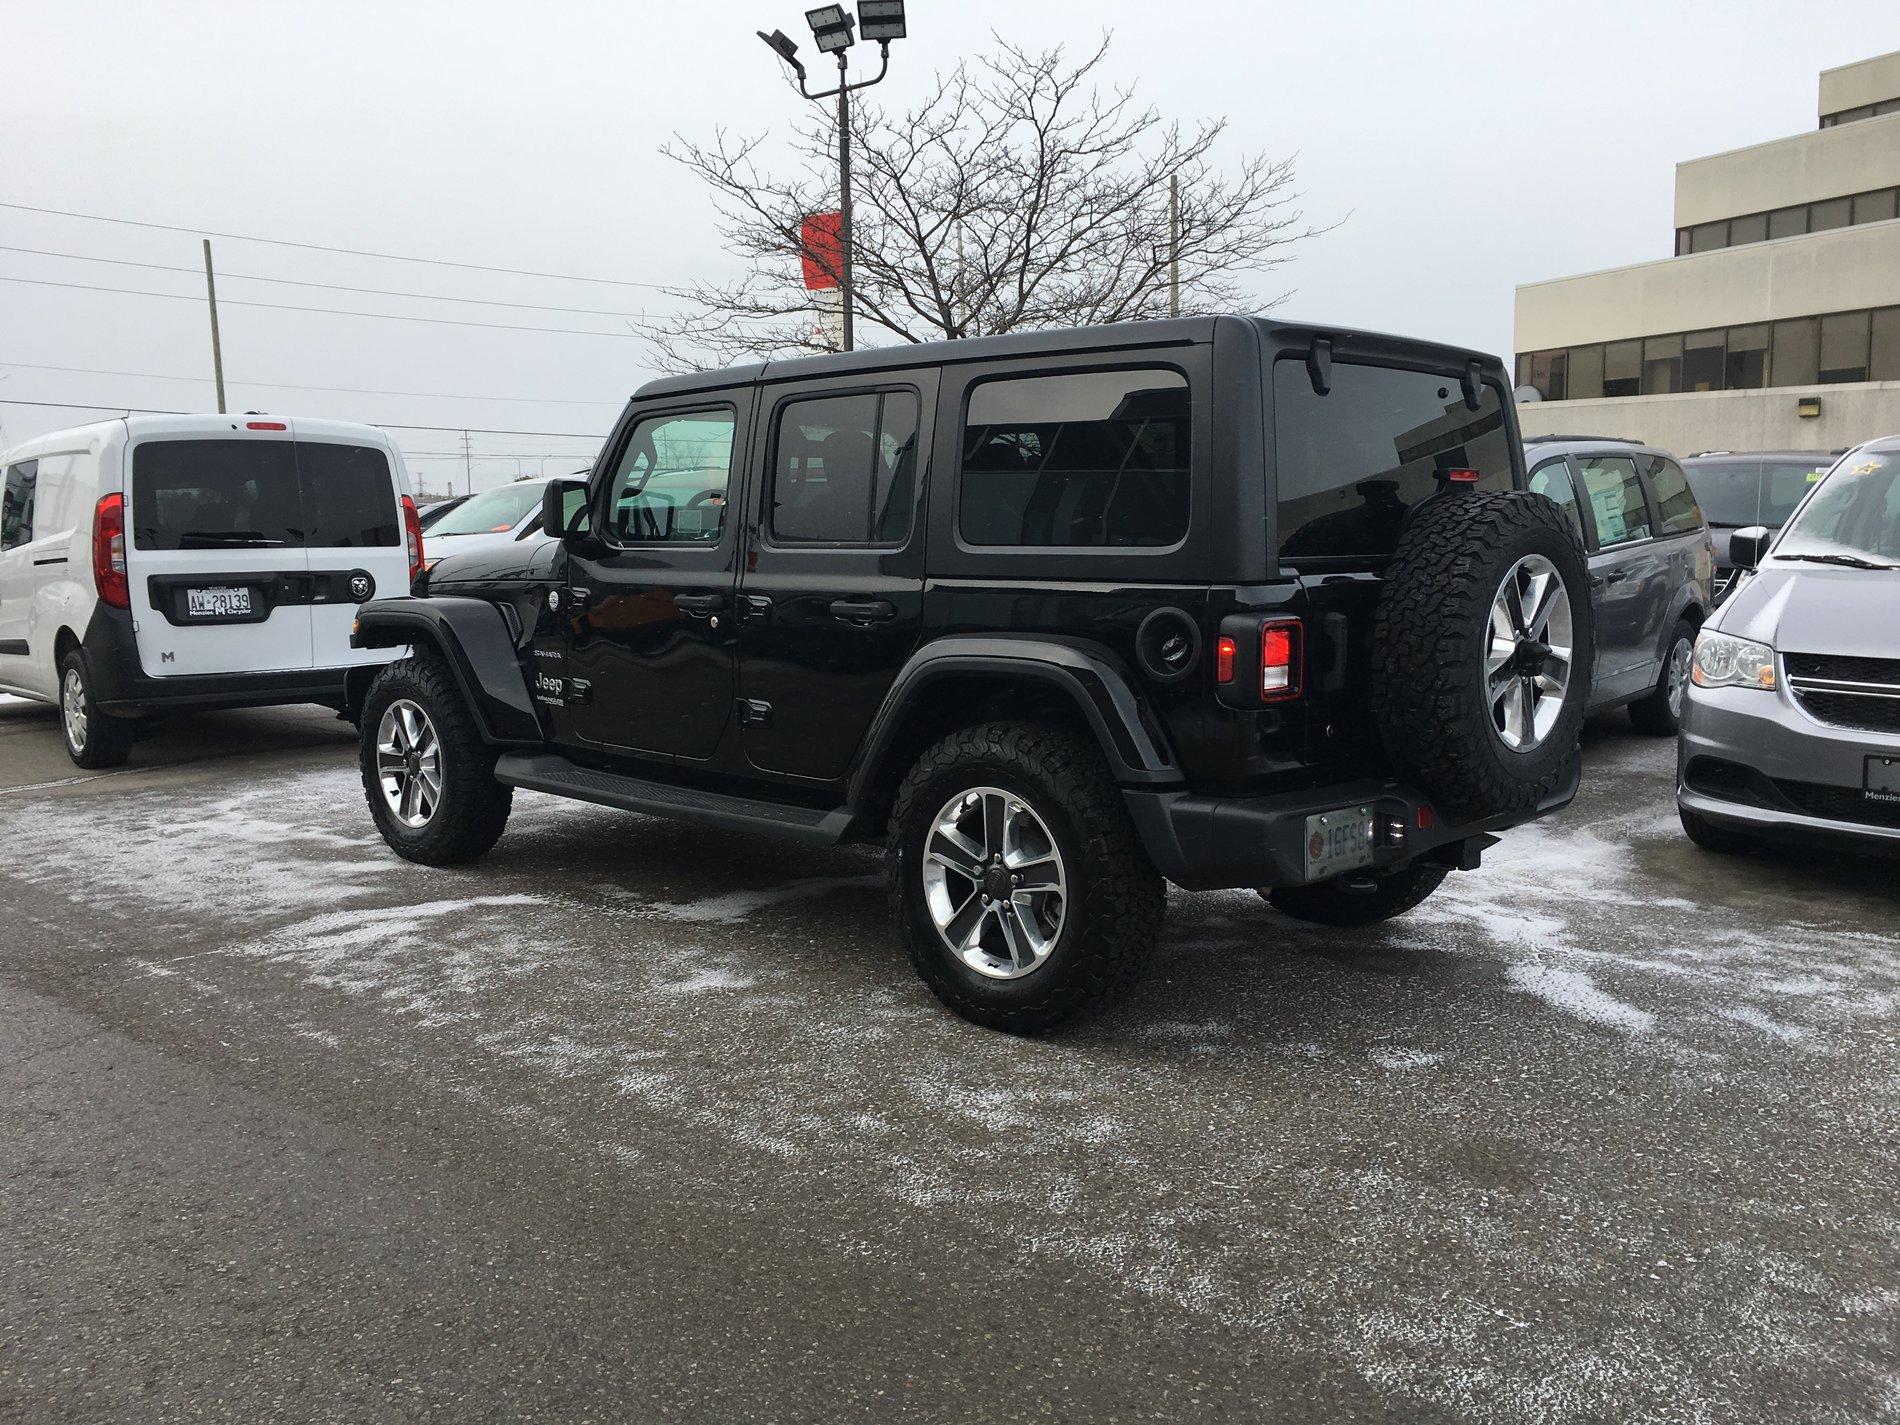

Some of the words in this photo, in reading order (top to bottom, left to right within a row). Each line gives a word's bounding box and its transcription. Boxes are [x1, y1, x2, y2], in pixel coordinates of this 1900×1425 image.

[212, 593, 249, 609] 28139
[534, 650, 562, 659] SAHARA
[535, 672, 563, 695] Jeep
